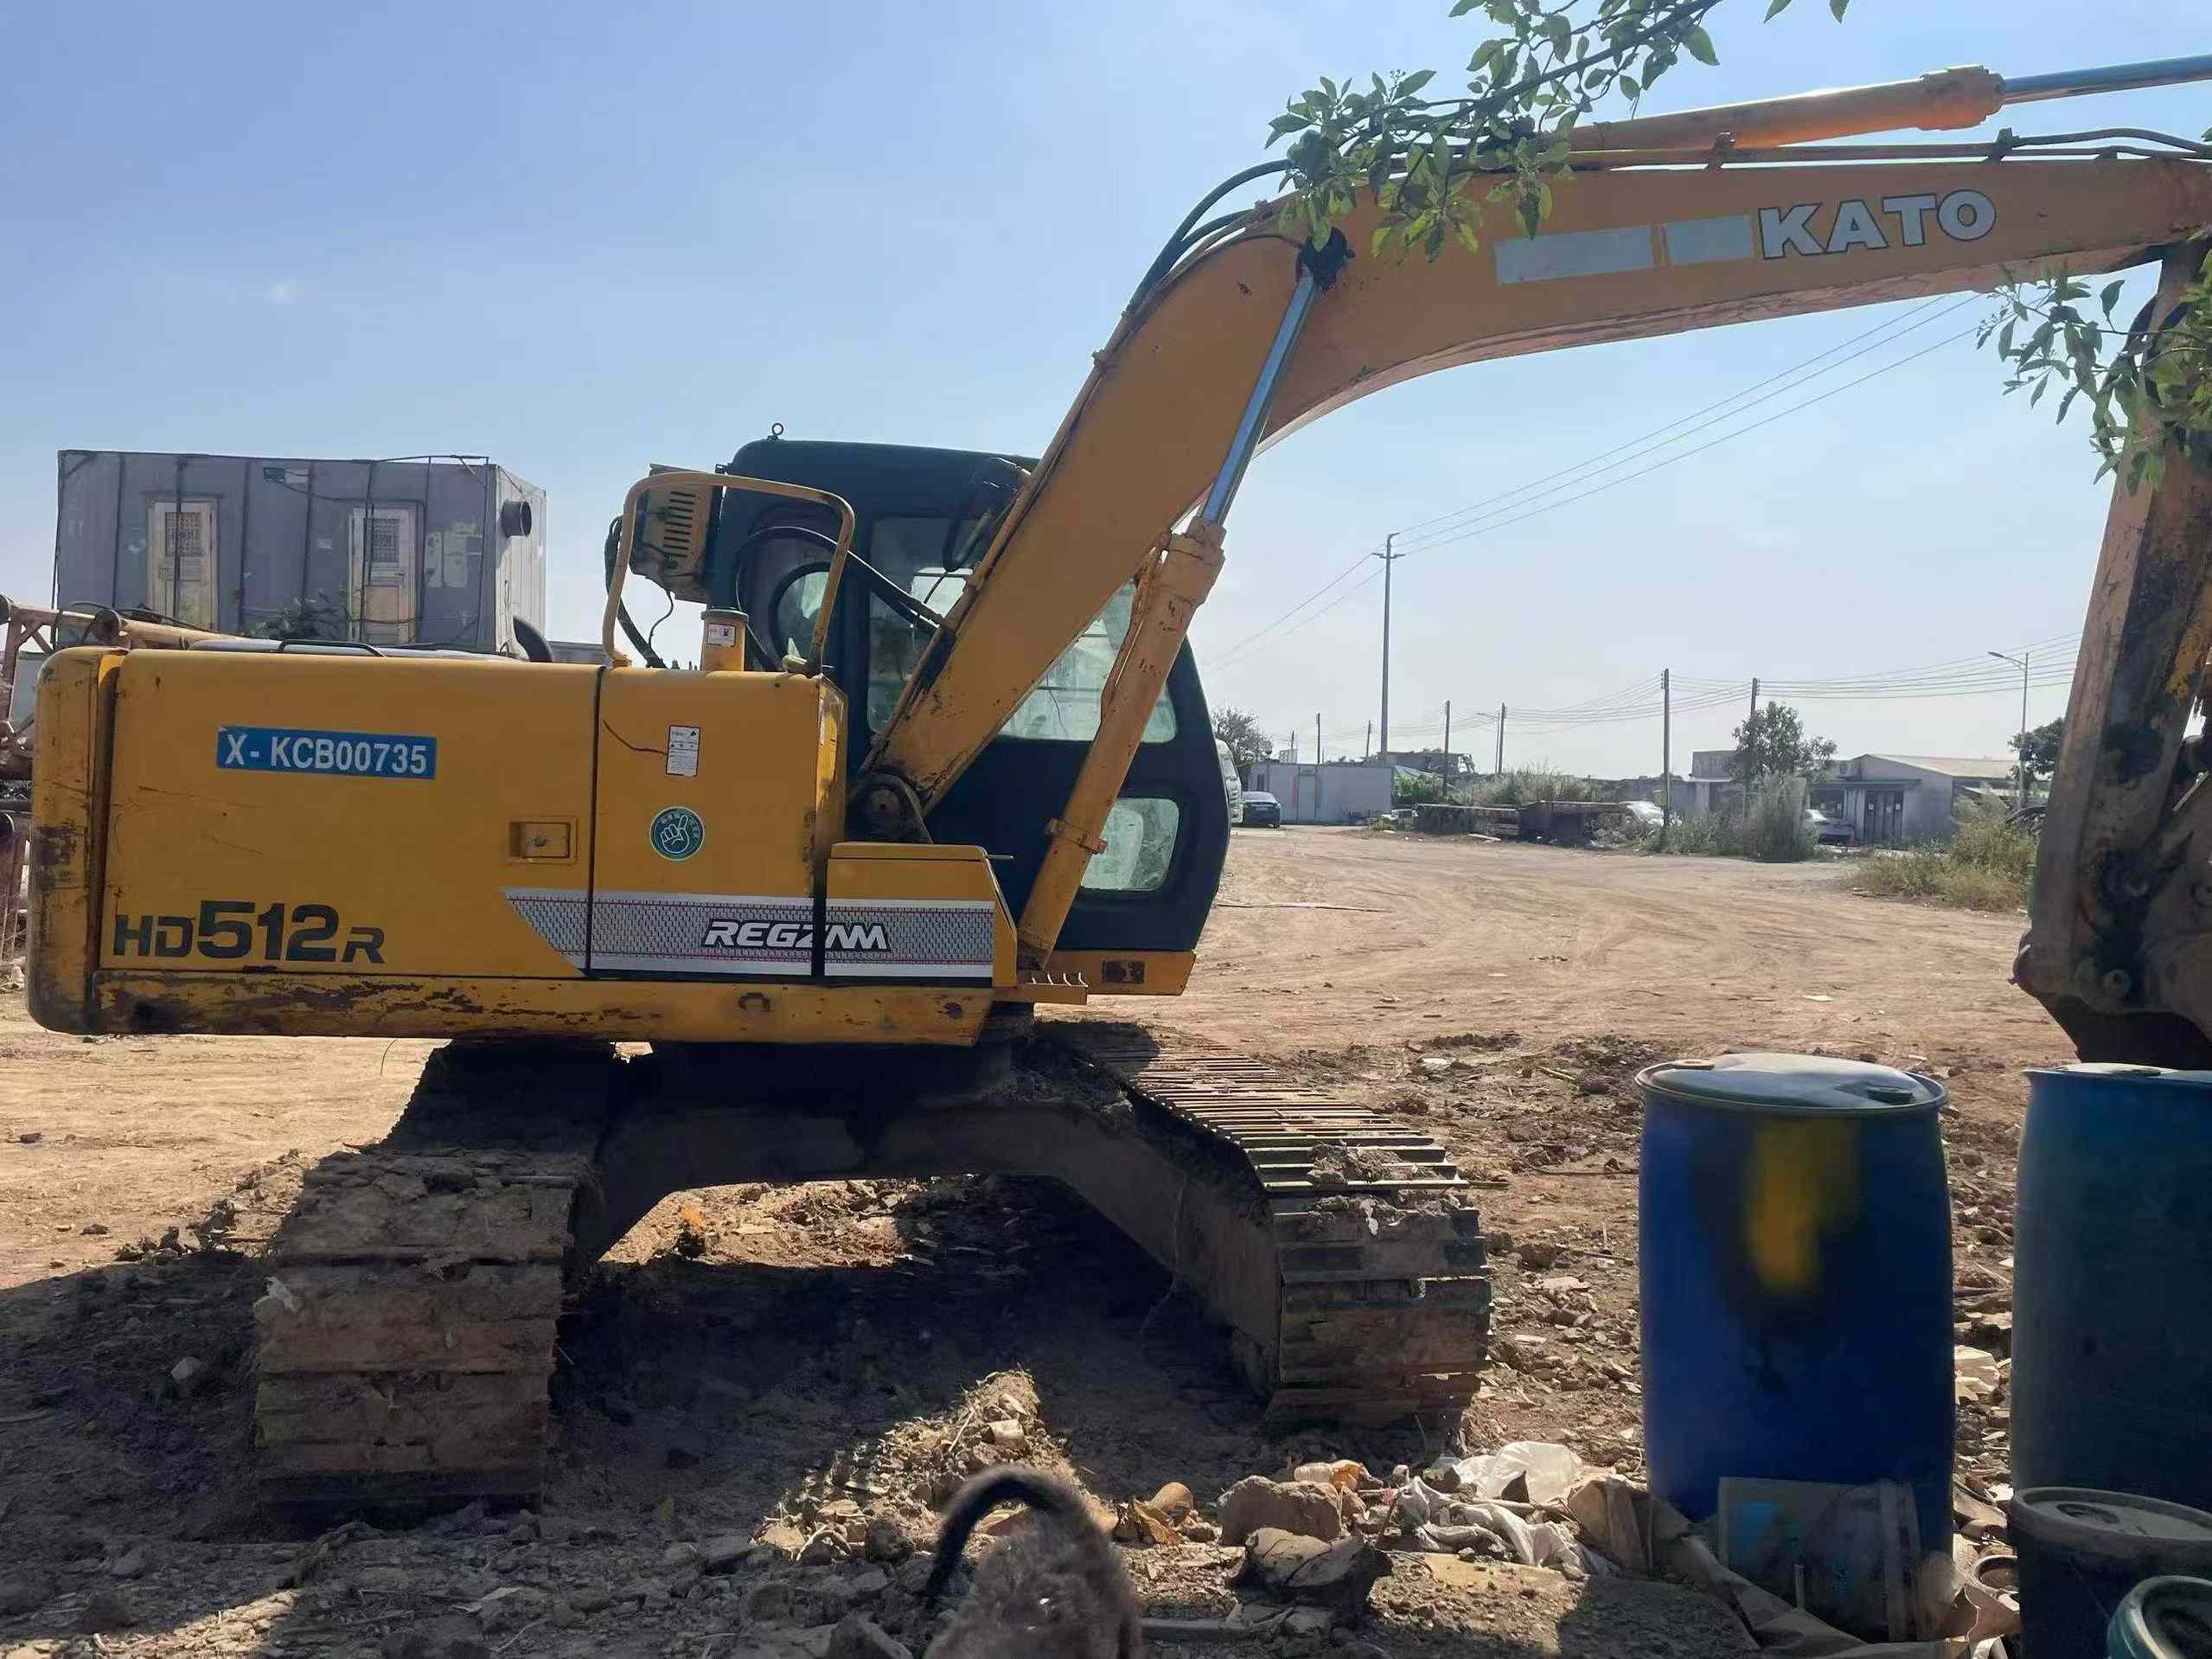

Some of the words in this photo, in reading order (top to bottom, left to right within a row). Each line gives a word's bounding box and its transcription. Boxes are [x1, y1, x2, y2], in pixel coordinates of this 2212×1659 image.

[1758, 189, 1997, 259] KATO
[270, 736, 427, 775] KCB00735
[113, 900, 386, 964] HD512R
